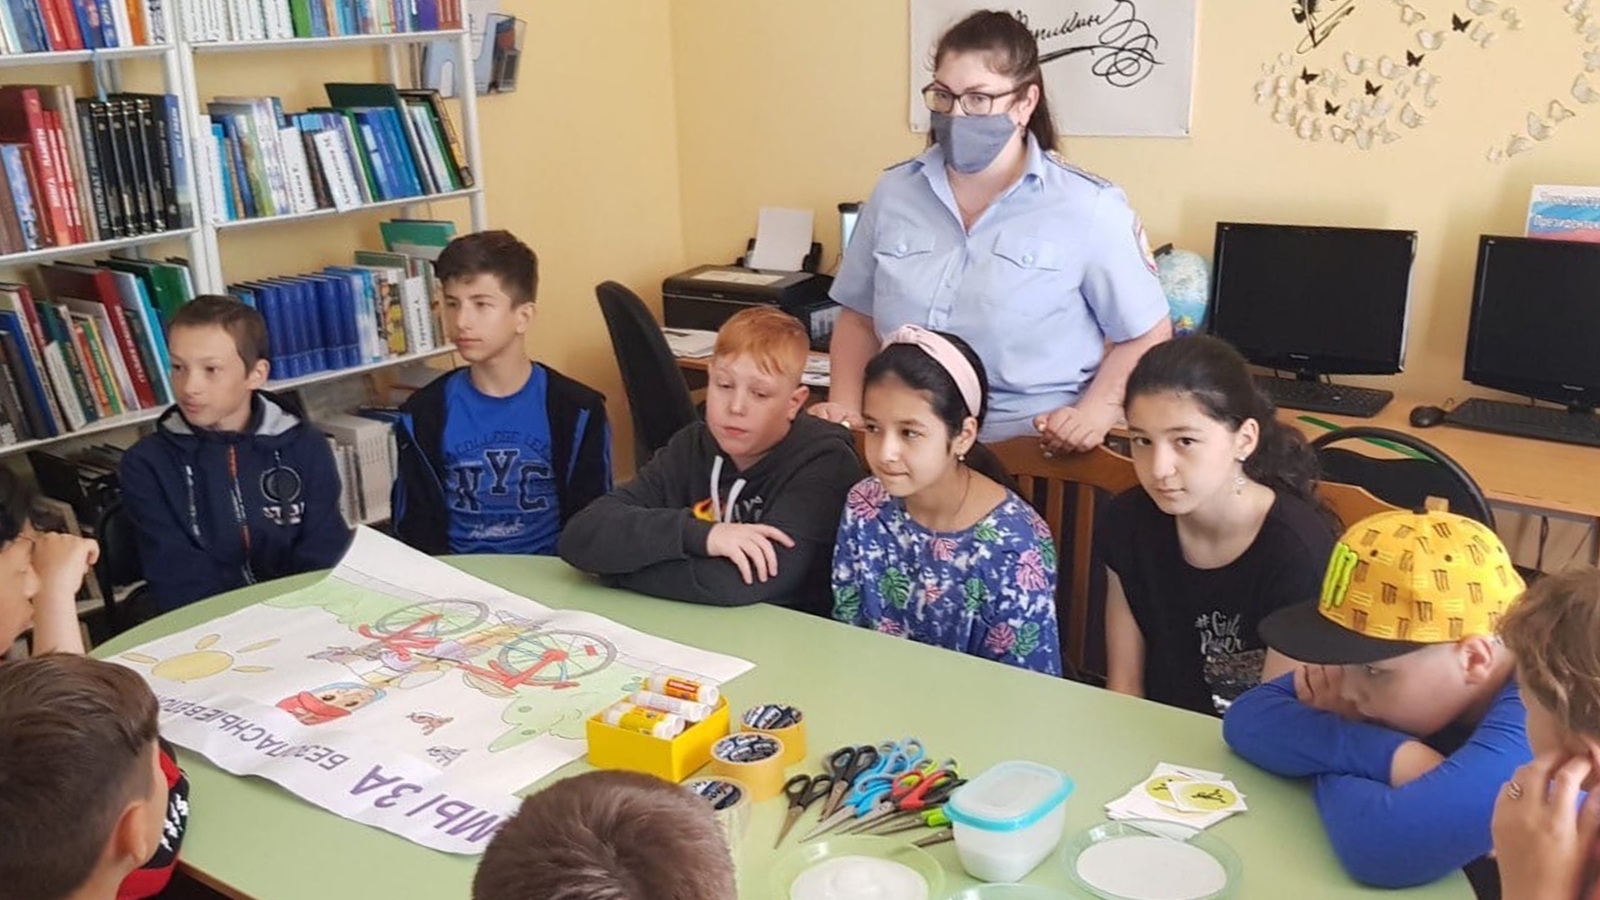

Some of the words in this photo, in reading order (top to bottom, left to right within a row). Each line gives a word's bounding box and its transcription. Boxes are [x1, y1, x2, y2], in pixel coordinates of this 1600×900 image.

[451, 447, 552, 514] NYC
[350, 764, 424, 808] ЗА
[404, 793, 502, 842] МЫ
